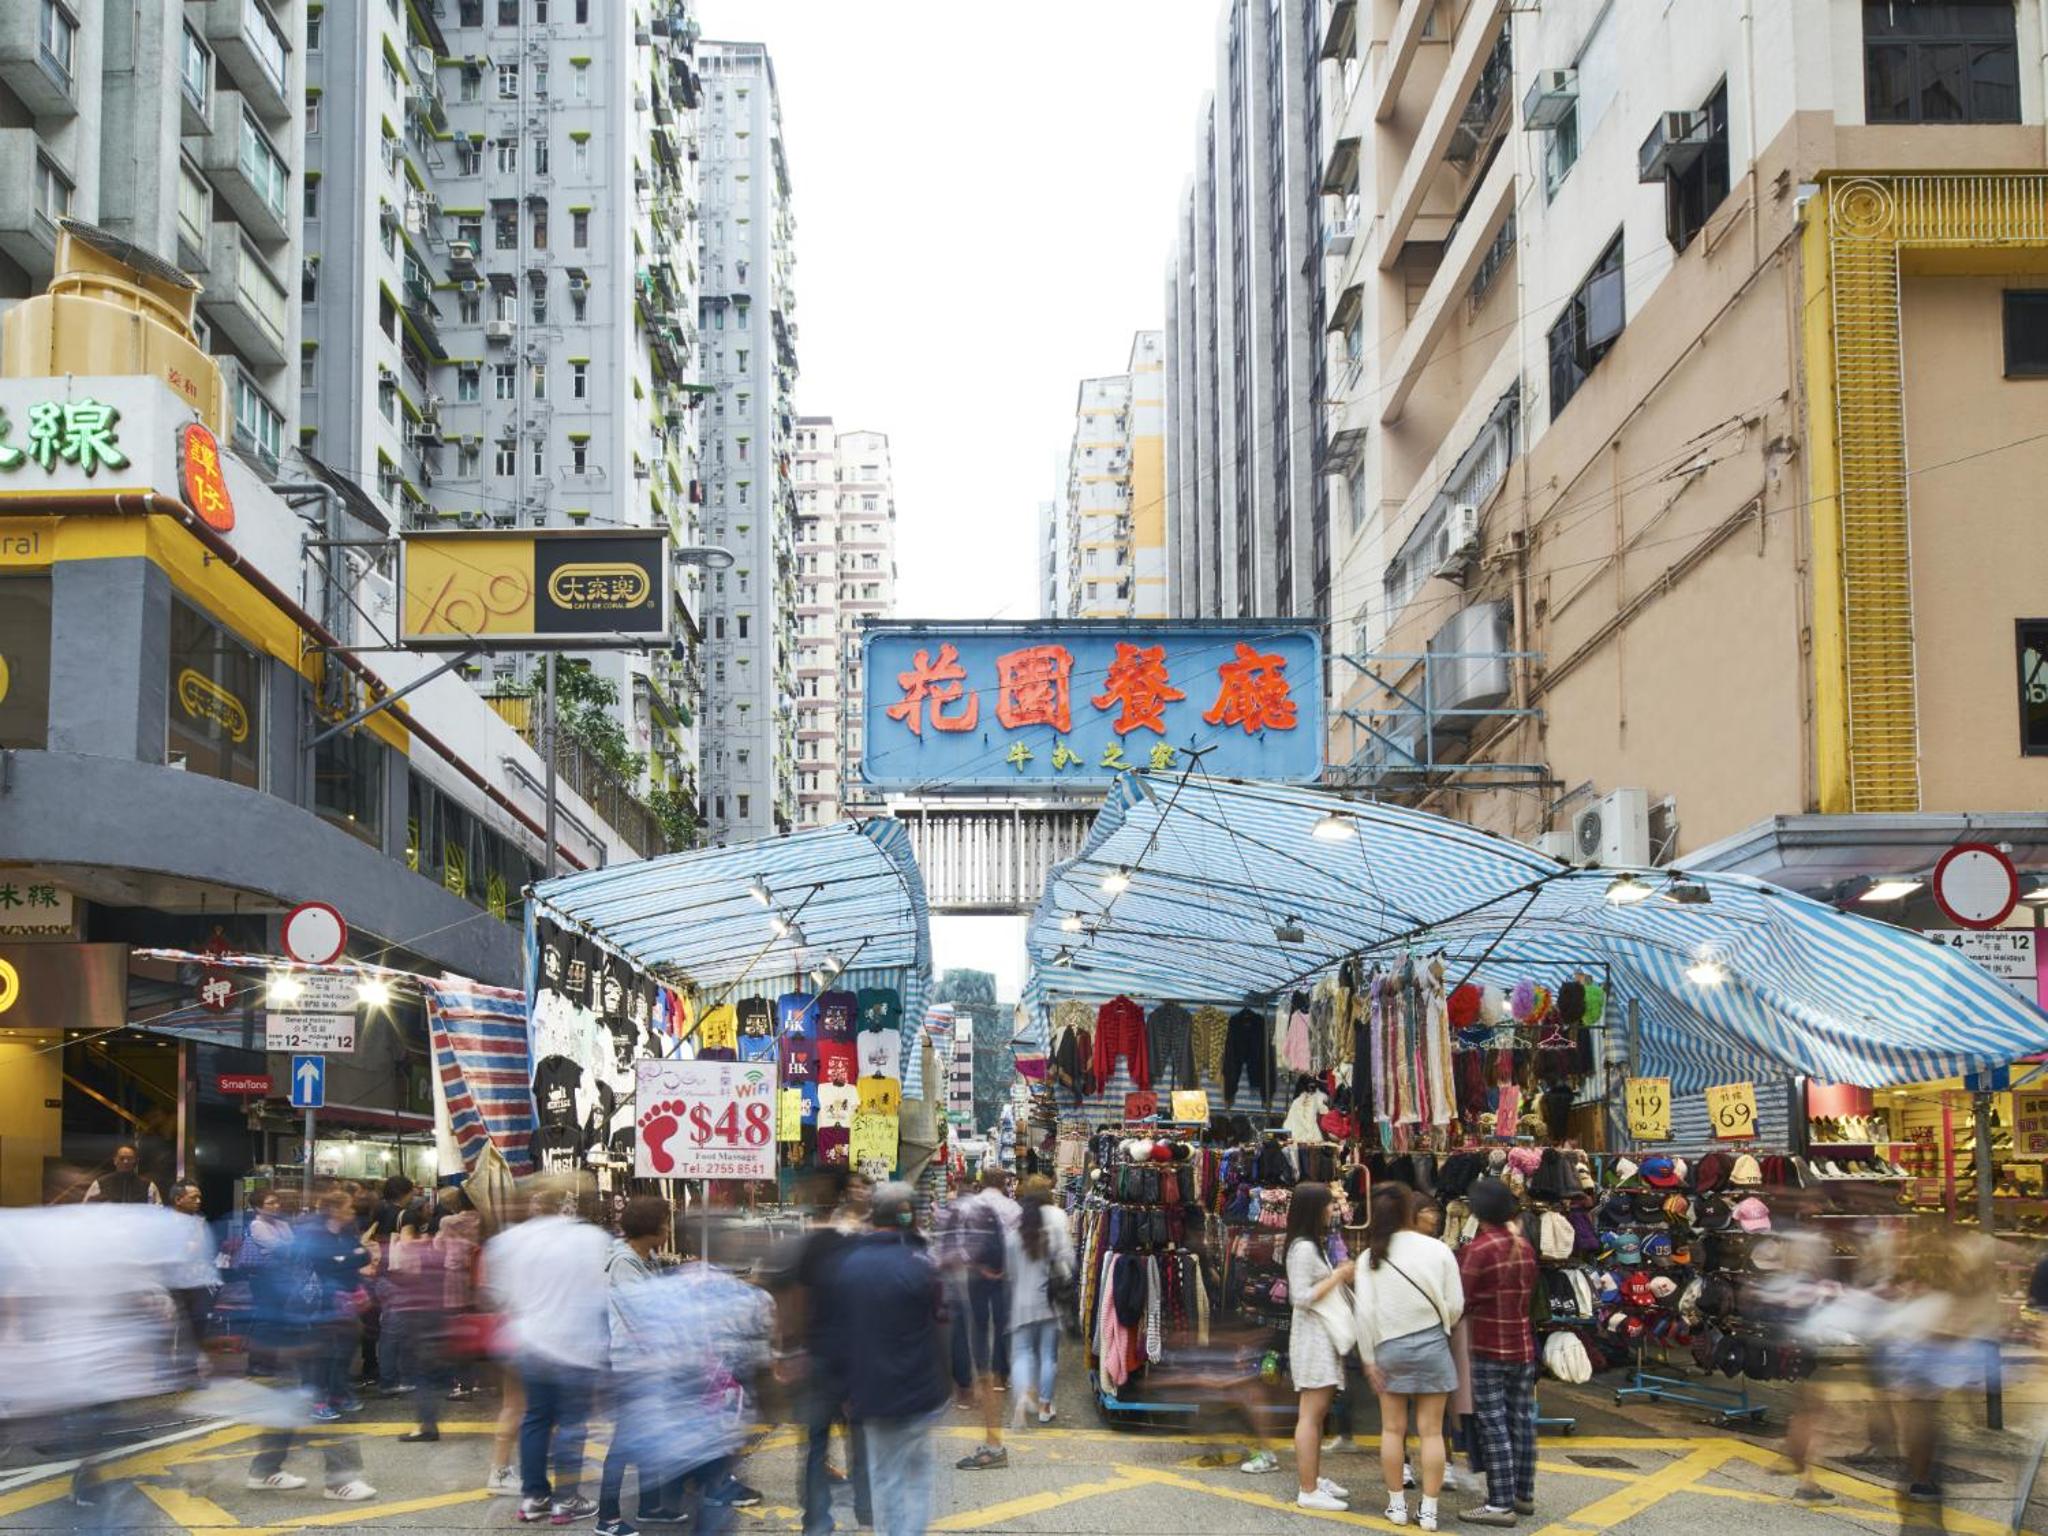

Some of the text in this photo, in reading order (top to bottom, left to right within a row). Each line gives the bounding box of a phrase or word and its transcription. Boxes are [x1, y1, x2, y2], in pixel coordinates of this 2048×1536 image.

[886, 641, 1299, 736] 花園餐廳
[1006, 741, 1178, 772] 牛扒之家
[1952, 935, 1964, 948] 4
[2011, 935, 2030, 949] 12
[202, 977, 232, 1008] 押
[784, 1020, 805, 1032] HK
[285, 1035, 300, 1047] 12
[337, 1036, 353, 1048] 12
[788, 1063, 809, 1074] HK
[1720, 1103, 1751, 1128] 69
[689, 1101, 771, 1149] $48
[718, 1151, 757, 1162] Massage
[705, 1163, 734, 1174] 2755
